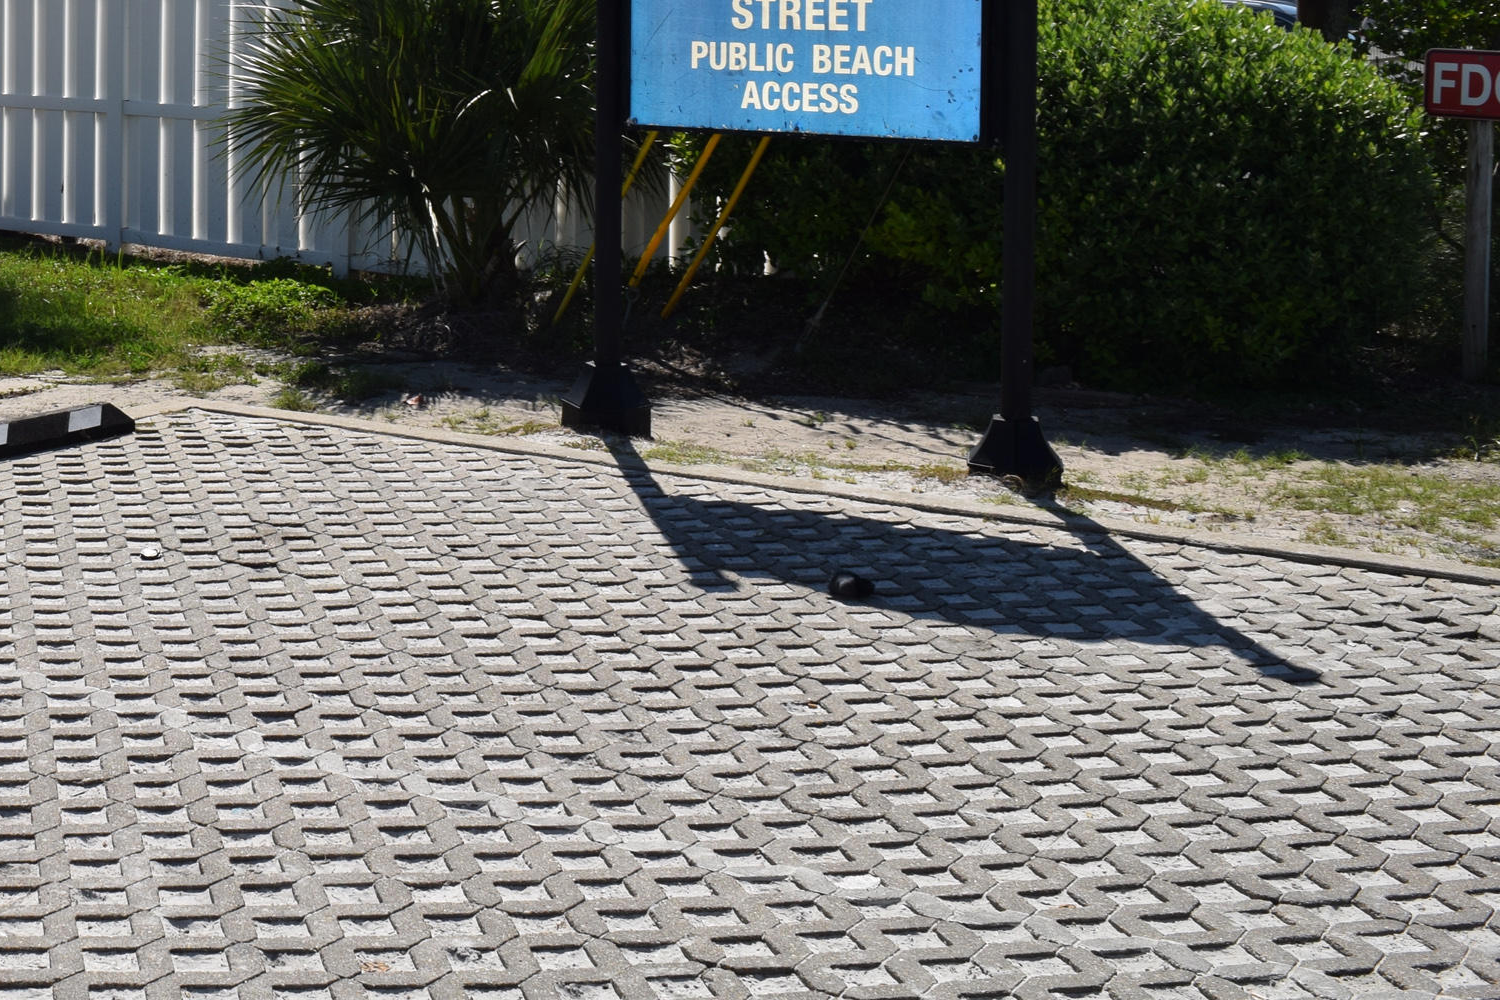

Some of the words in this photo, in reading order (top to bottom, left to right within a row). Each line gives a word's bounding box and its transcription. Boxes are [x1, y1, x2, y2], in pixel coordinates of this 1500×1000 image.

[691, 41, 794, 73] PUBLIC
[812, 44, 915, 76] BEACH
[741, 81, 858, 114] ACCESS
[1432, 62, 1500, 106] FD
